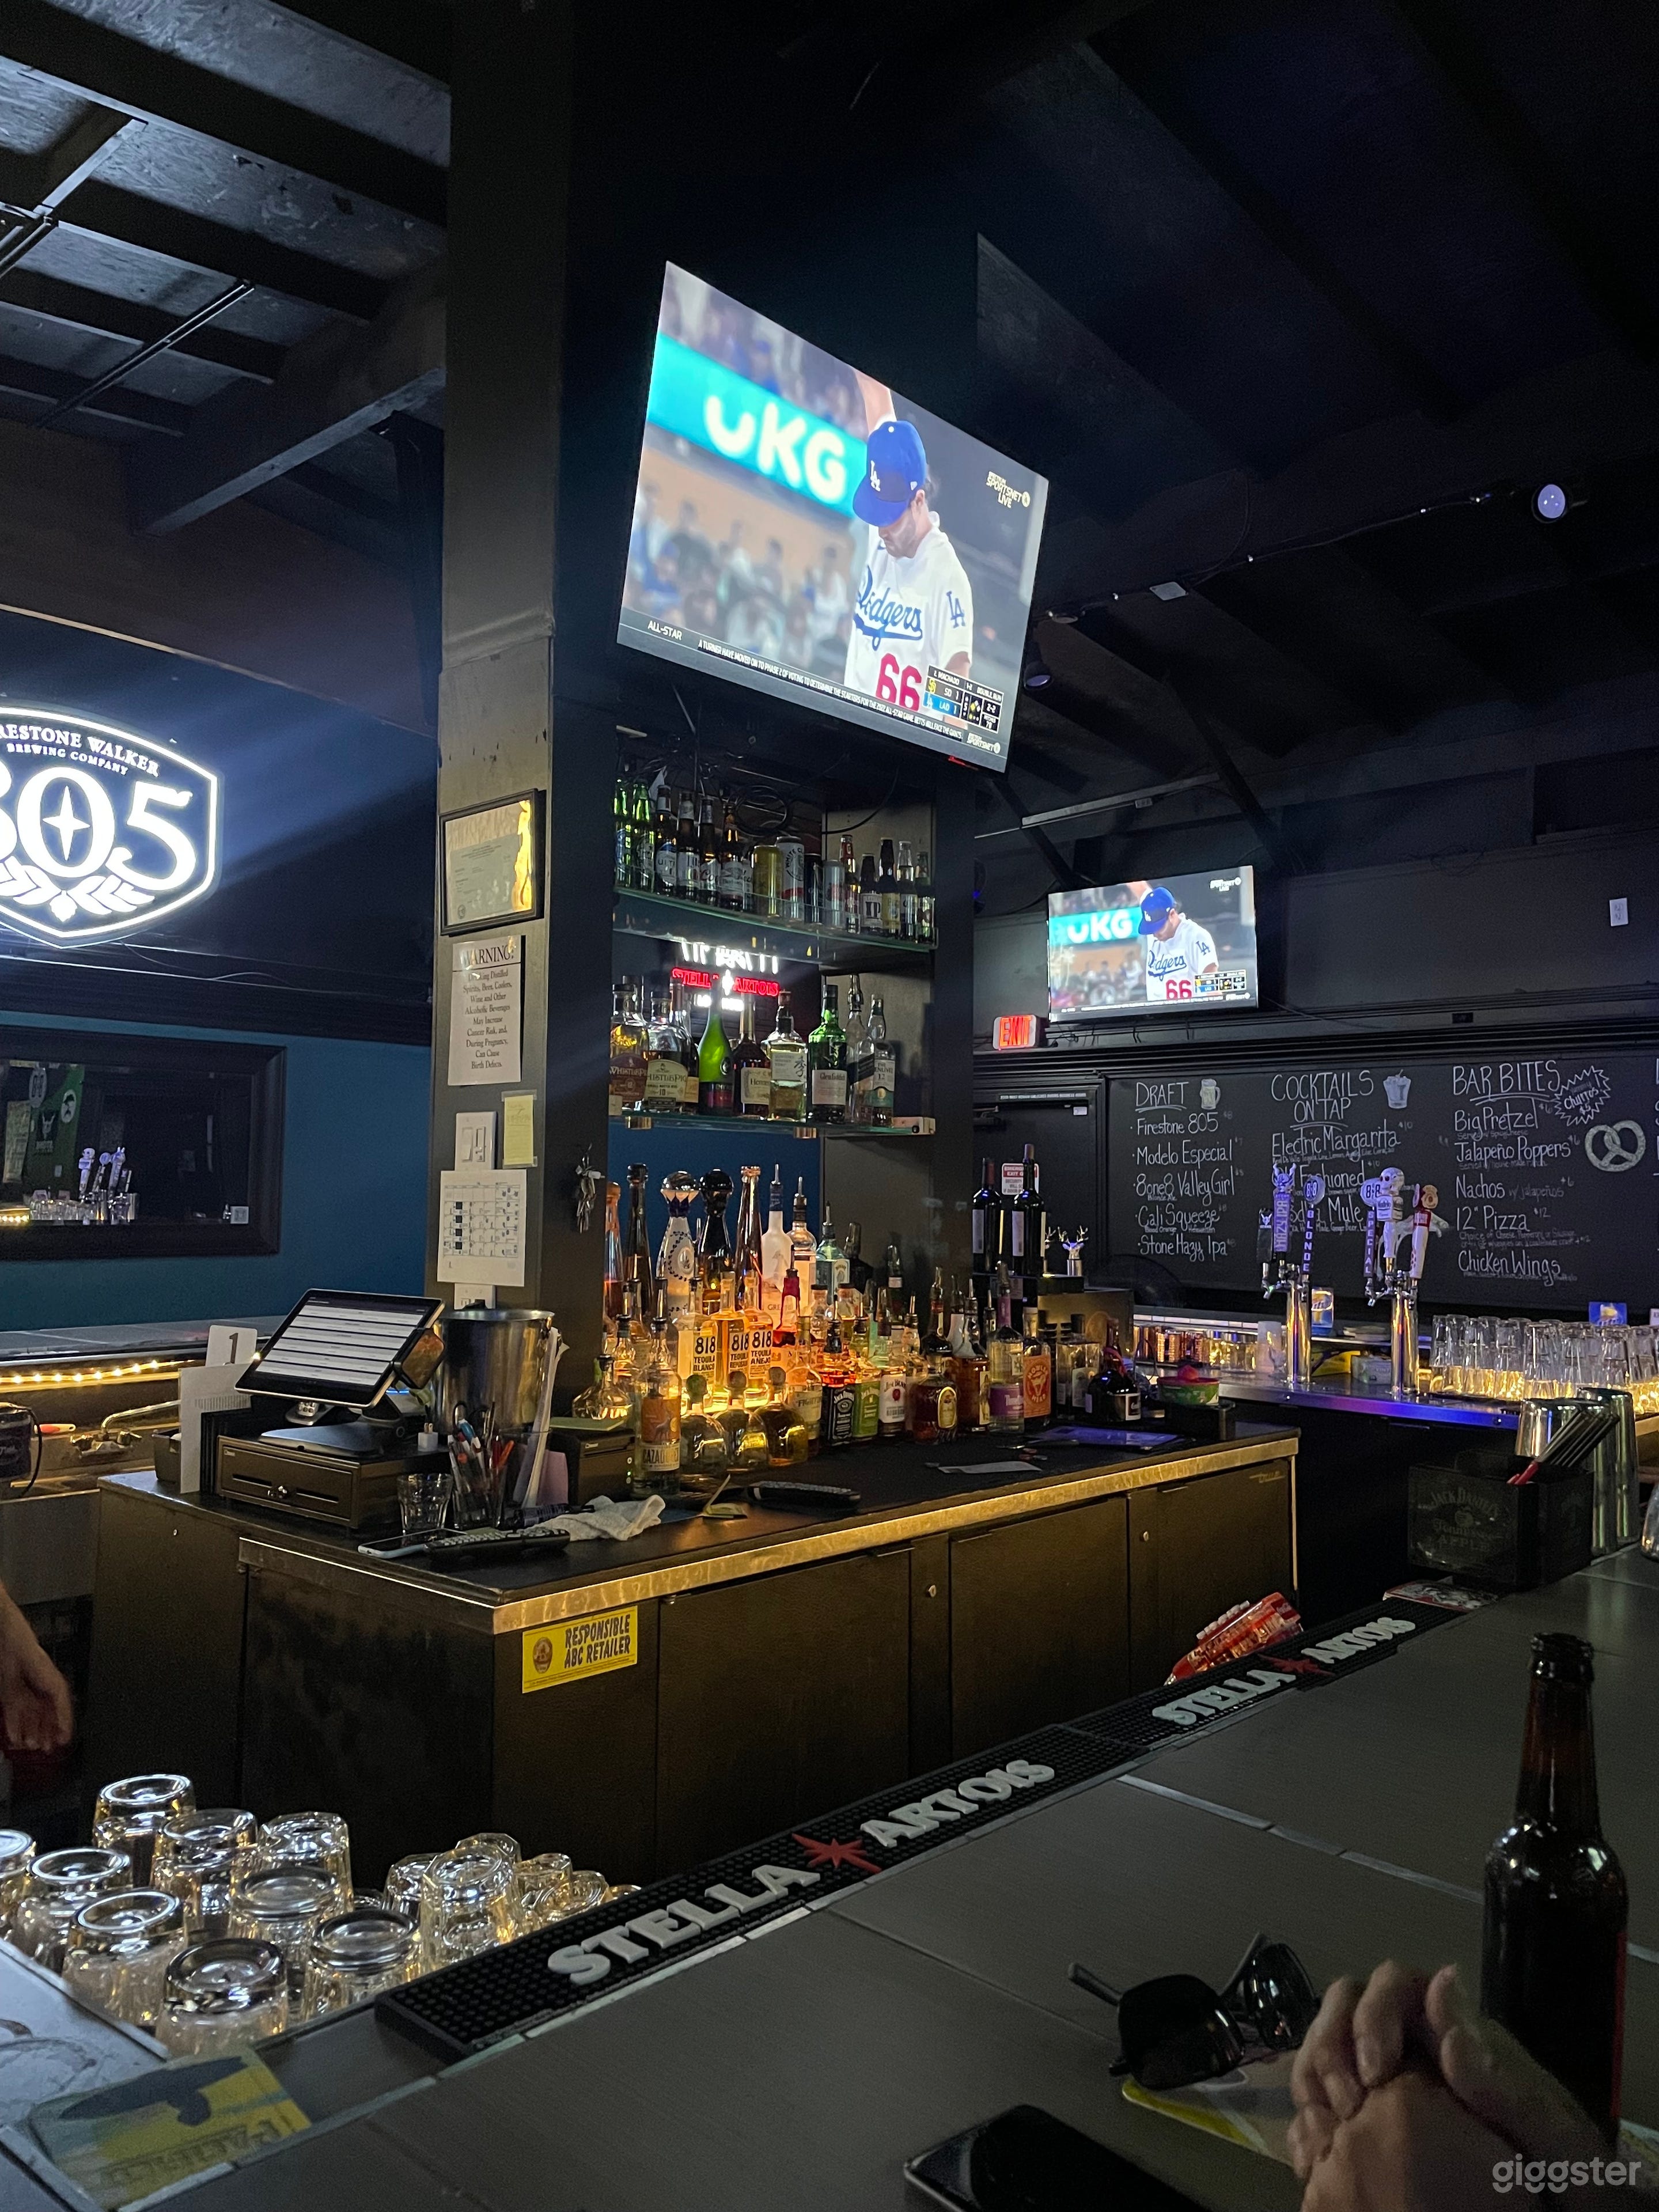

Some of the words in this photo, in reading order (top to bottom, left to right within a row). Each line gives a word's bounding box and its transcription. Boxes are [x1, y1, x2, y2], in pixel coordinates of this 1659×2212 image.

[704, 396, 848, 503] UKG
[986, 476, 1022, 502] SPORTSNET
[998, 493, 1012, 508] LIVE
[647, 620, 683, 641] ALL-STAR
[722, 647, 734, 660] HAVE
[734, 651, 751, 665] MOVED
[876, 653, 922, 711] 66
[938, 672, 960, 685] MACHADO
[940, 702, 950, 711] LAD
[7, 743, 66, 758] BREWING
[70, 751, 128, 776] COMPANY
[87, 736, 160, 777] WALKER
[0, 759, 196, 891] 05
[1067, 909, 1133, 944] UKG
[470, 995, 484, 1003] Wine
[484, 994, 493, 1002] and
[494, 993, 506, 1001] Other
[733, 977, 780, 997] ARTOIS
[1166, 980, 1192, 1000] 66
[465, 1006, 488, 1015] Alcoholic
[489, 1005, 510, 1014] Beverages
[473, 1017, 483, 1025] May
[485, 1015, 503, 1024] Increase
[466, 1039, 484, 1048] During
[467, 1028, 484, 1037] Cancer
[999, 1016, 1031, 1047] EXIT
[471, 1061, 484, 1070] Birth
[1136, 1082, 1189, 1107] DRAFT
[1271, 1070, 1374, 1104] COCKTAILS
[1453, 1066, 1493, 1101] BAR
[1499, 1060, 1560, 1093] BITES
[1137, 1114, 1185, 1135] Firestone
[1188, 1112, 1219, 1134] 805
[1294, 1099, 1315, 1123] ON
[1317, 1097, 1351, 1120] TAP
[1455, 1109, 1483, 1141] Big
[1483, 1098, 1539, 1131] Pretzel
[1137, 1142, 1178, 1165] Modelo
[1183, 1139, 1232, 1169] Especial
[1272, 1128, 1322, 1157] Electric
[1324, 1119, 1402, 1162] Margarita
[1455, 1141, 1515, 1170] Jalapeño
[1517, 1135, 1571, 1168] Poppers
[1137, 1173, 1174, 1196] 8one8
[1178, 1170, 1211, 1206] Valley
[1211, 1165, 1234, 1196] Girl
[1456, 1173, 1505, 1199] Nachos
[1138, 1205, 1164, 1227] Cali
[1166, 1203, 1220, 1232] Squeeze
[1276, 1200, 1288, 1217] IPA
[1328, 1194, 1363, 1222] Mule
[1483, 1205, 1530, 1232] Pizza
[1140, 1234, 1175, 1255] Stone
[1176, 1233, 1205, 1262] Hazy
[1208, 1235, 1228, 1262] Ipa
[1277, 1218, 1288, 1251] HAZY
[1303, 1210, 1315, 1272] BLONDE
[1365, 1211, 1374, 1274] SPECIAL
[1458, 1249, 1509, 1274] Chicken
[1512, 1249, 1561, 1287] Wings
[228, 1332, 238, 1364] 1
[695, 1336, 716, 1355] 818
[731, 1334, 749, 1352] 818
[752, 1331, 772, 1349] 818
[884, 1381, 894, 1392] JIM
[565, 1614, 631, 1649] RESPONSIBLE
[565, 1646, 584, 1669] ABC
[586, 1635, 631, 1664] RETAILER
[1151, 1668, 1297, 1726] STELLA
[1300, 1616, 1416, 1664] ARTOIS
[547, 1863, 820, 1986] STELLA
[860, 1759, 1056, 1847] ARTOIS
